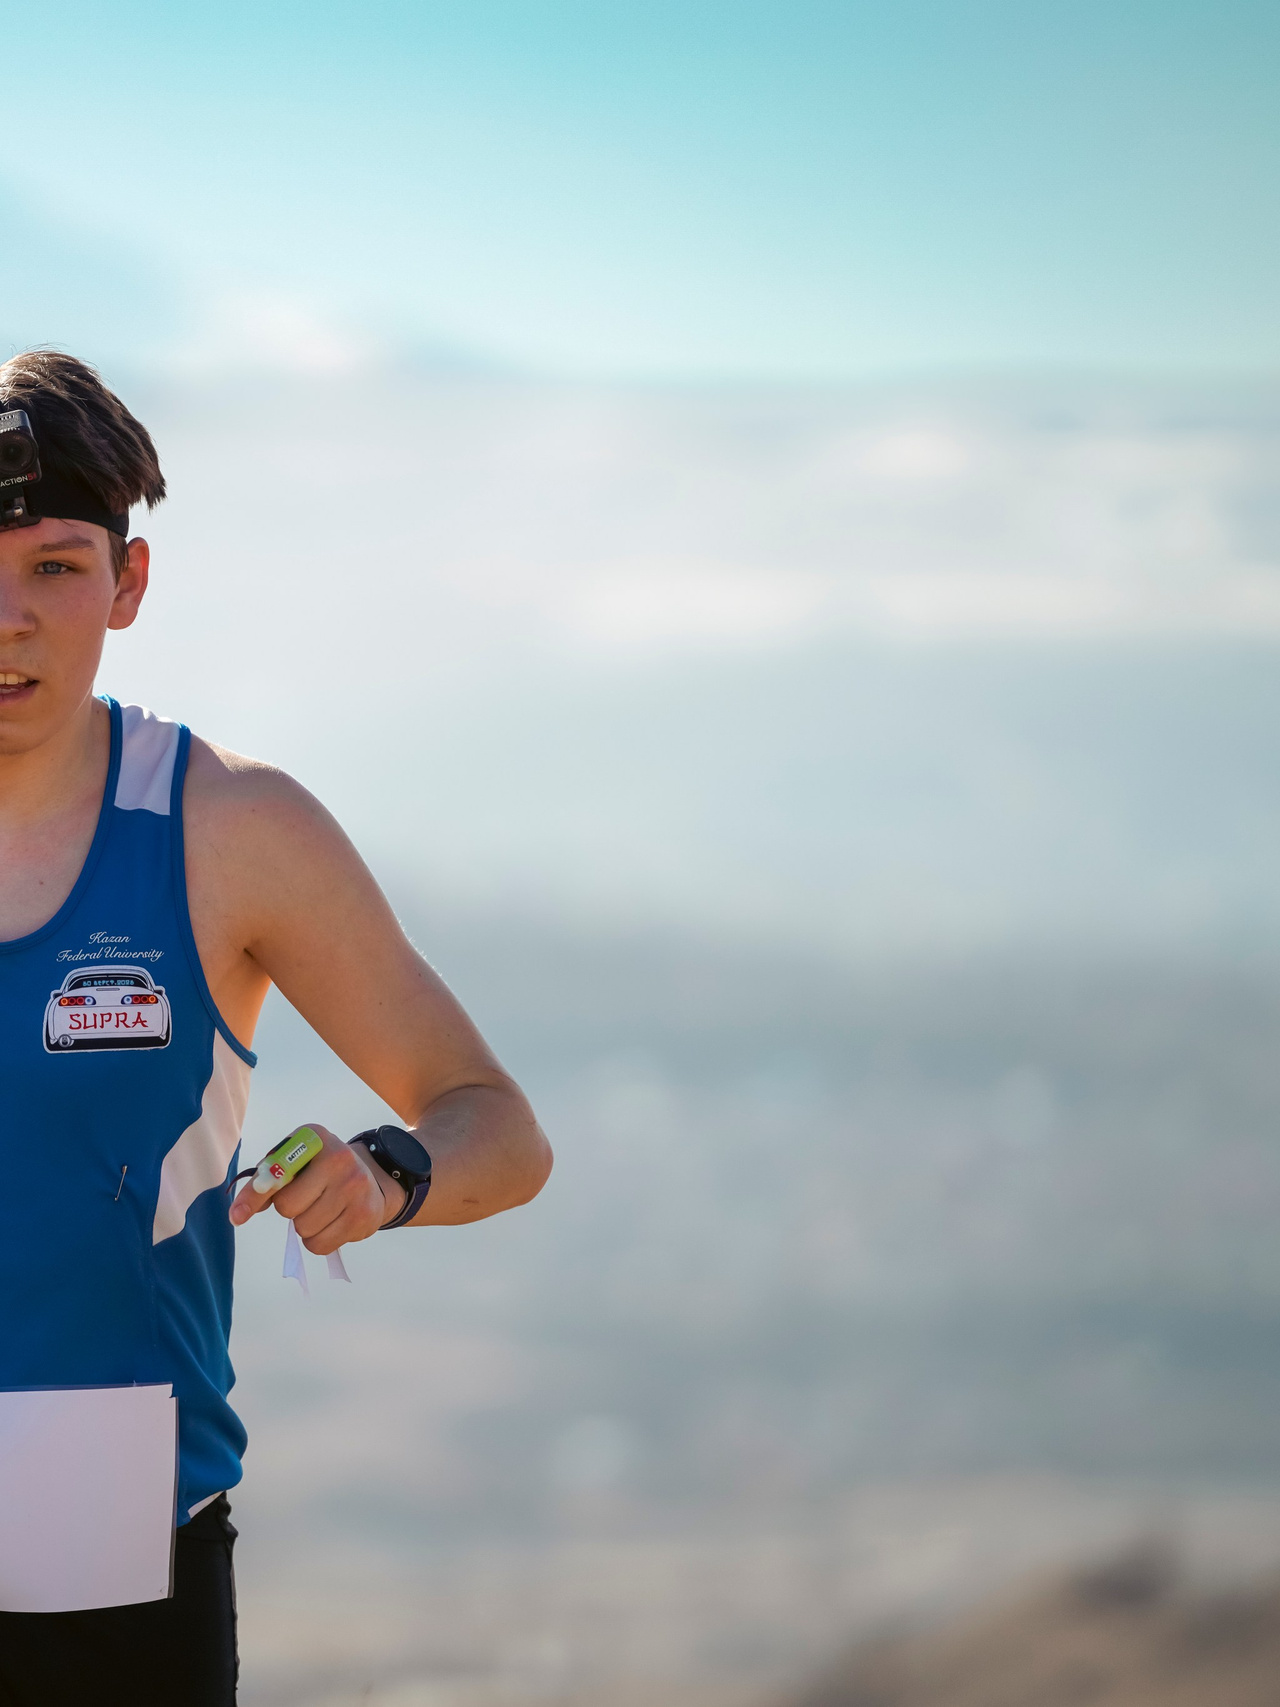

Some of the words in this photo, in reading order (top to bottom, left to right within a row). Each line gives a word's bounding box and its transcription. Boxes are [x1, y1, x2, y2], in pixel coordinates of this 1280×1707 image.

[88, 931, 131, 944] Kazan
[56, 949, 102, 962] Federal
[103, 946, 165, 962] University
[68, 1011, 148, 1030] SUPRA
